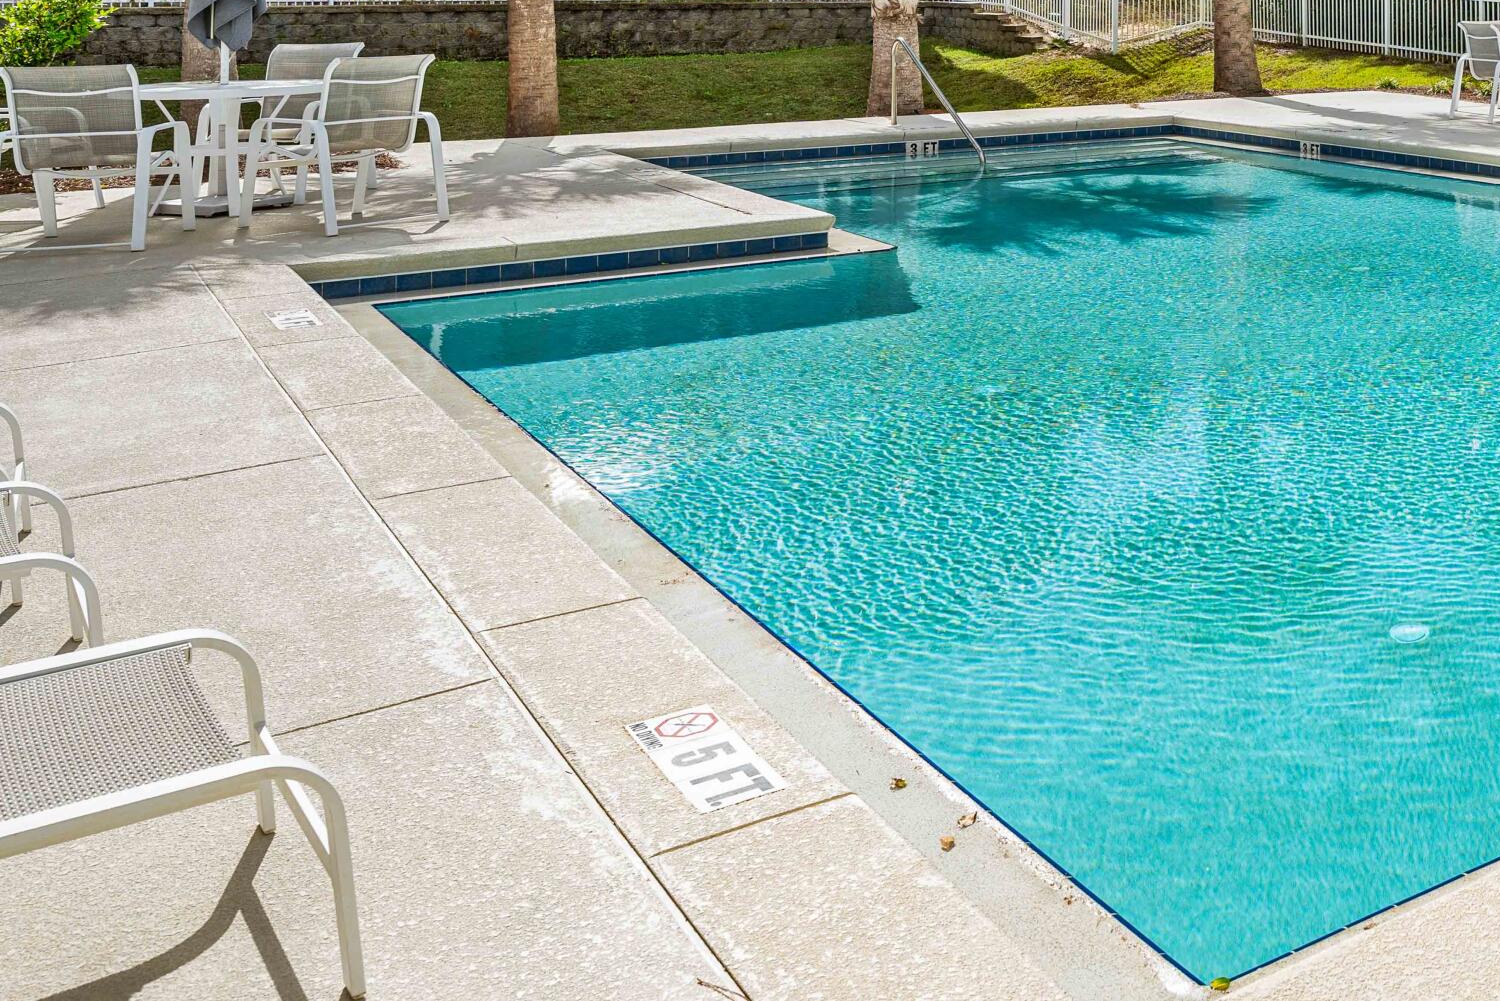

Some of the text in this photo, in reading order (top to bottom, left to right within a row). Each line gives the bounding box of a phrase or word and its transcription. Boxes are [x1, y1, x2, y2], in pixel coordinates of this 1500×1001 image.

[910, 141, 938, 155] 3 FT
[1302, 143, 1320, 155] 3 FT
[628, 722, 664, 750] NO DIVING
[671, 741, 776, 807] 5 FT.
